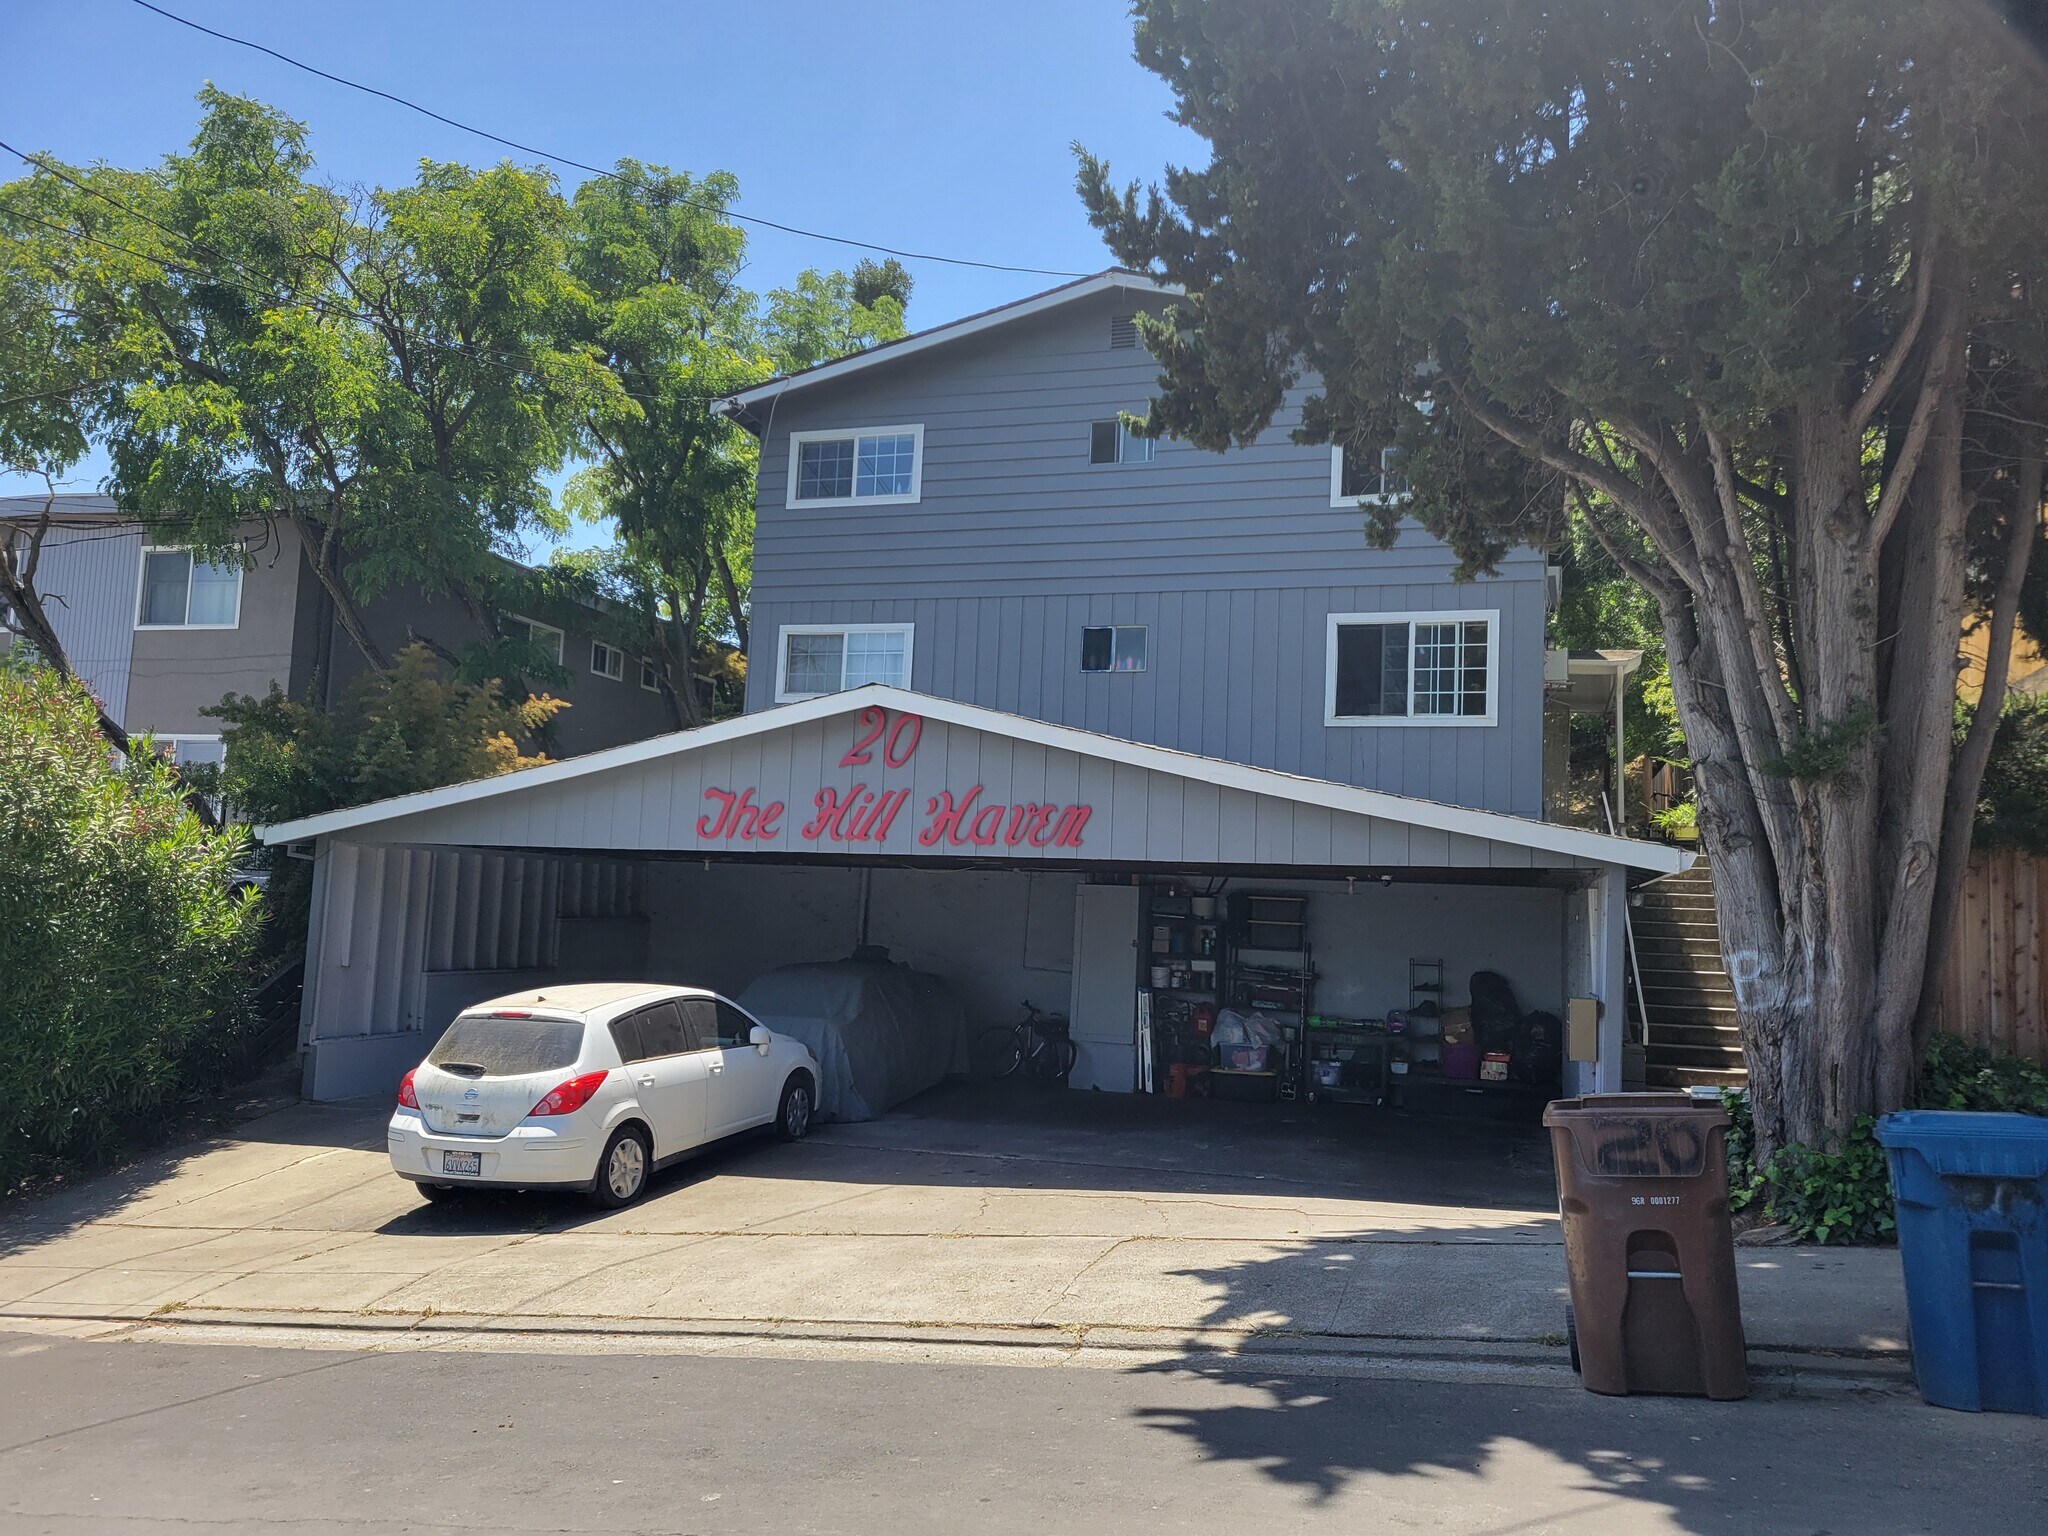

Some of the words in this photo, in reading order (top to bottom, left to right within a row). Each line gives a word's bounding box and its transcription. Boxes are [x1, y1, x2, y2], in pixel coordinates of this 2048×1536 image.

[838, 706, 922, 768] 20
[697, 787, 785, 840] The
[802, 784, 911, 841] Hill
[919, 786, 1092, 847] Haven
[1594, 1117, 1700, 1175] 20
[1650, 1196, 1680, 1205] 0001277
